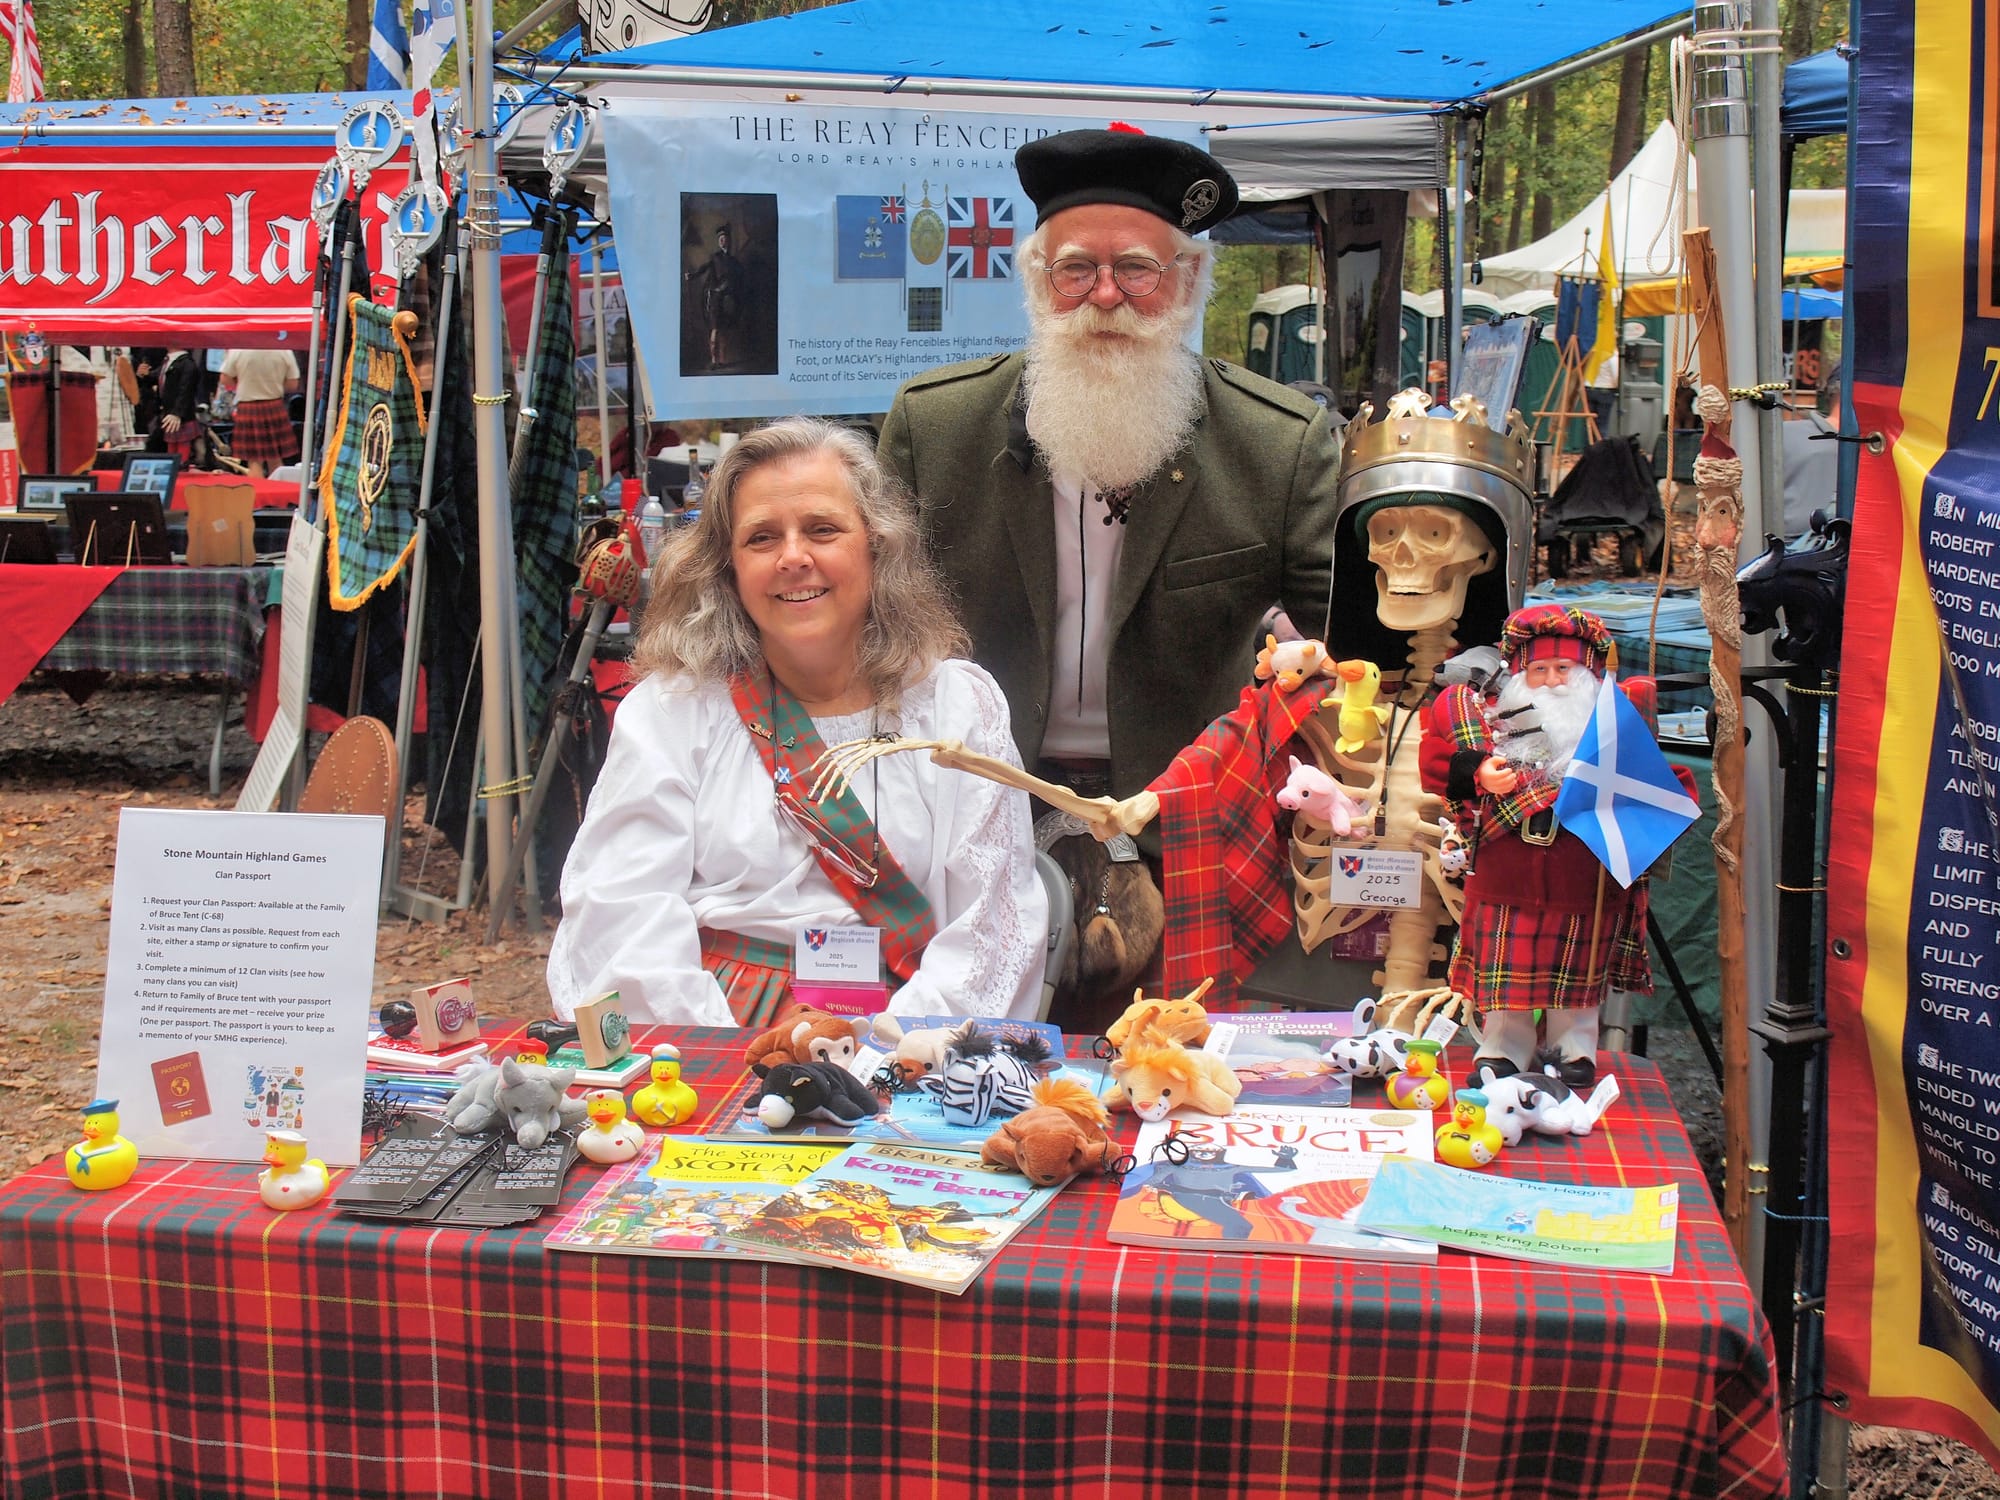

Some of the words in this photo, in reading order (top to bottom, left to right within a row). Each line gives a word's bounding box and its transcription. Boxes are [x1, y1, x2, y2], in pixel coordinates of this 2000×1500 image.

[342, 103, 368, 127] MANU
[381, 104, 401, 130] FORTI
[730, 116, 795, 142] THE
[815, 119, 897, 145] REAY
[778, 153, 830, 164] LORD
[847, 155, 917, 167] REAY'S
[788, 338, 806, 349] The
[808, 338, 842, 351] history
[844, 338, 857, 348] of
[857, 338, 872, 348] the
[875, 337, 898, 350] Reay
[953, 335, 992, 348] Highland
[796, 355, 820, 366] Foot,
[822, 356, 832, 365] or
[885, 353, 944, 366] Highlanders,
[789, 372, 829, 382] Account
[831, 371, 842, 381] of
[844, 371, 855, 381] its
[858, 370, 897, 381] Services
[900, 370, 909, 379] in
[1930, 530, 1995, 557] ROBERT
[1930, 587, 1972, 612] SCOTS
[1944, 778, 1980, 797] AND
[163, 848, 193, 859] Stone
[195, 850, 243, 860] Mountain
[245, 851, 290, 863] Highland
[292, 853, 327, 863] Games
[215, 870, 233, 879] Clan
[235, 871, 271, 882] Passport
[1367, 876, 1401, 884] 2025
[1933, 864, 1986, 885] LIMIT
[142, 896, 150, 905] 1.
[151, 897, 182, 906] Request
[183, 899, 201, 907] your
[202, 898, 219, 906] Clan
[221, 899, 257, 909] Passport:
[258, 901, 294, 910] Available
[305, 902, 318, 910] the
[320, 903, 346, 913] Family
[1360, 890, 1407, 906] George
[159, 910, 181, 919] Bruce
[183, 911, 199, 919] Tent
[201, 912, 224, 922] (C-68)
[140, 923, 147, 931] 2.
[148, 923, 165, 931] Visit
[177, 926, 199, 934] many
[200, 925, 221, 933] Clans
[232, 927, 266, 935] possible.
[268, 928, 300, 937] Request
[301, 929, 320, 937] from
[322, 930, 340, 938] each
[1924, 919, 1970, 938] AND
[1923, 945, 1984, 969] FULLY
[136, 963, 143, 971] 3.
[144, 963, 182, 973] Complete
[189, 965, 227, 974] minimum
[228, 966, 237, 974] of
[238, 967, 248, 975] 12
[249, 967, 267, 976] Clan
[268, 968, 288, 977] visits
[290, 969, 306, 978] (see
[307, 970, 325, 978] how
[142, 990, 168, 998] Return
[180, 992, 205, 1001] Family
[217, 993, 239, 1002] Bruce
[258, 995, 276, 1003] with
[297, 998, 332, 1006] passport
[165, 1005, 216, 1014] requirements
[256, 1009, 285, 1017] receive
[306, 1011, 325, 1020] prize
[825, 1002, 864, 1014] SPONSOR
[1920, 998, 1969, 1023] OVER
[1976, 1012, 1992, 1027] A
[140, 1016, 159, 1026] (One
[160, 1019, 174, 1027] per
[175, 1020, 211, 1028] passport.
[213, 1020, 227, 1028] The
[264, 1022, 271, 1030] is
[272, 1024, 294, 1032] yours
[306, 1024, 325, 1034] keep
[1917, 1077, 1976, 1108] ENDED
[1919, 1100, 2000, 1141] MANGLED
[1168, 1119, 1409, 1154] BRUCE
[1922, 1122, 1964, 1154] BACK
[1972, 1145, 1996, 1165] TO
[690, 1147, 727, 1158] The
[736, 1149, 794, 1162] Story
[808, 1150, 831, 1163] of
[877, 1147, 957, 1165] BRAVE
[844, 1156, 964, 1181] ROBERT
[1925, 1142, 1958, 1172] WITH
[1961, 1163, 1993, 1189] THE
[891, 1177, 925, 1187] THE
[933, 1181, 1030, 1200] BRUCE
[1458, 1172, 1508, 1185] Hewie
[1518, 1182, 1548, 1192] The
[1553, 1188, 1612, 1197] Haggis
[1925, 1212, 1959, 1243] WAS
[1442, 1224, 1489, 1239] helps
[1495, 1234, 1532, 1247] King
[1538, 1241, 1601, 1254] Robert
